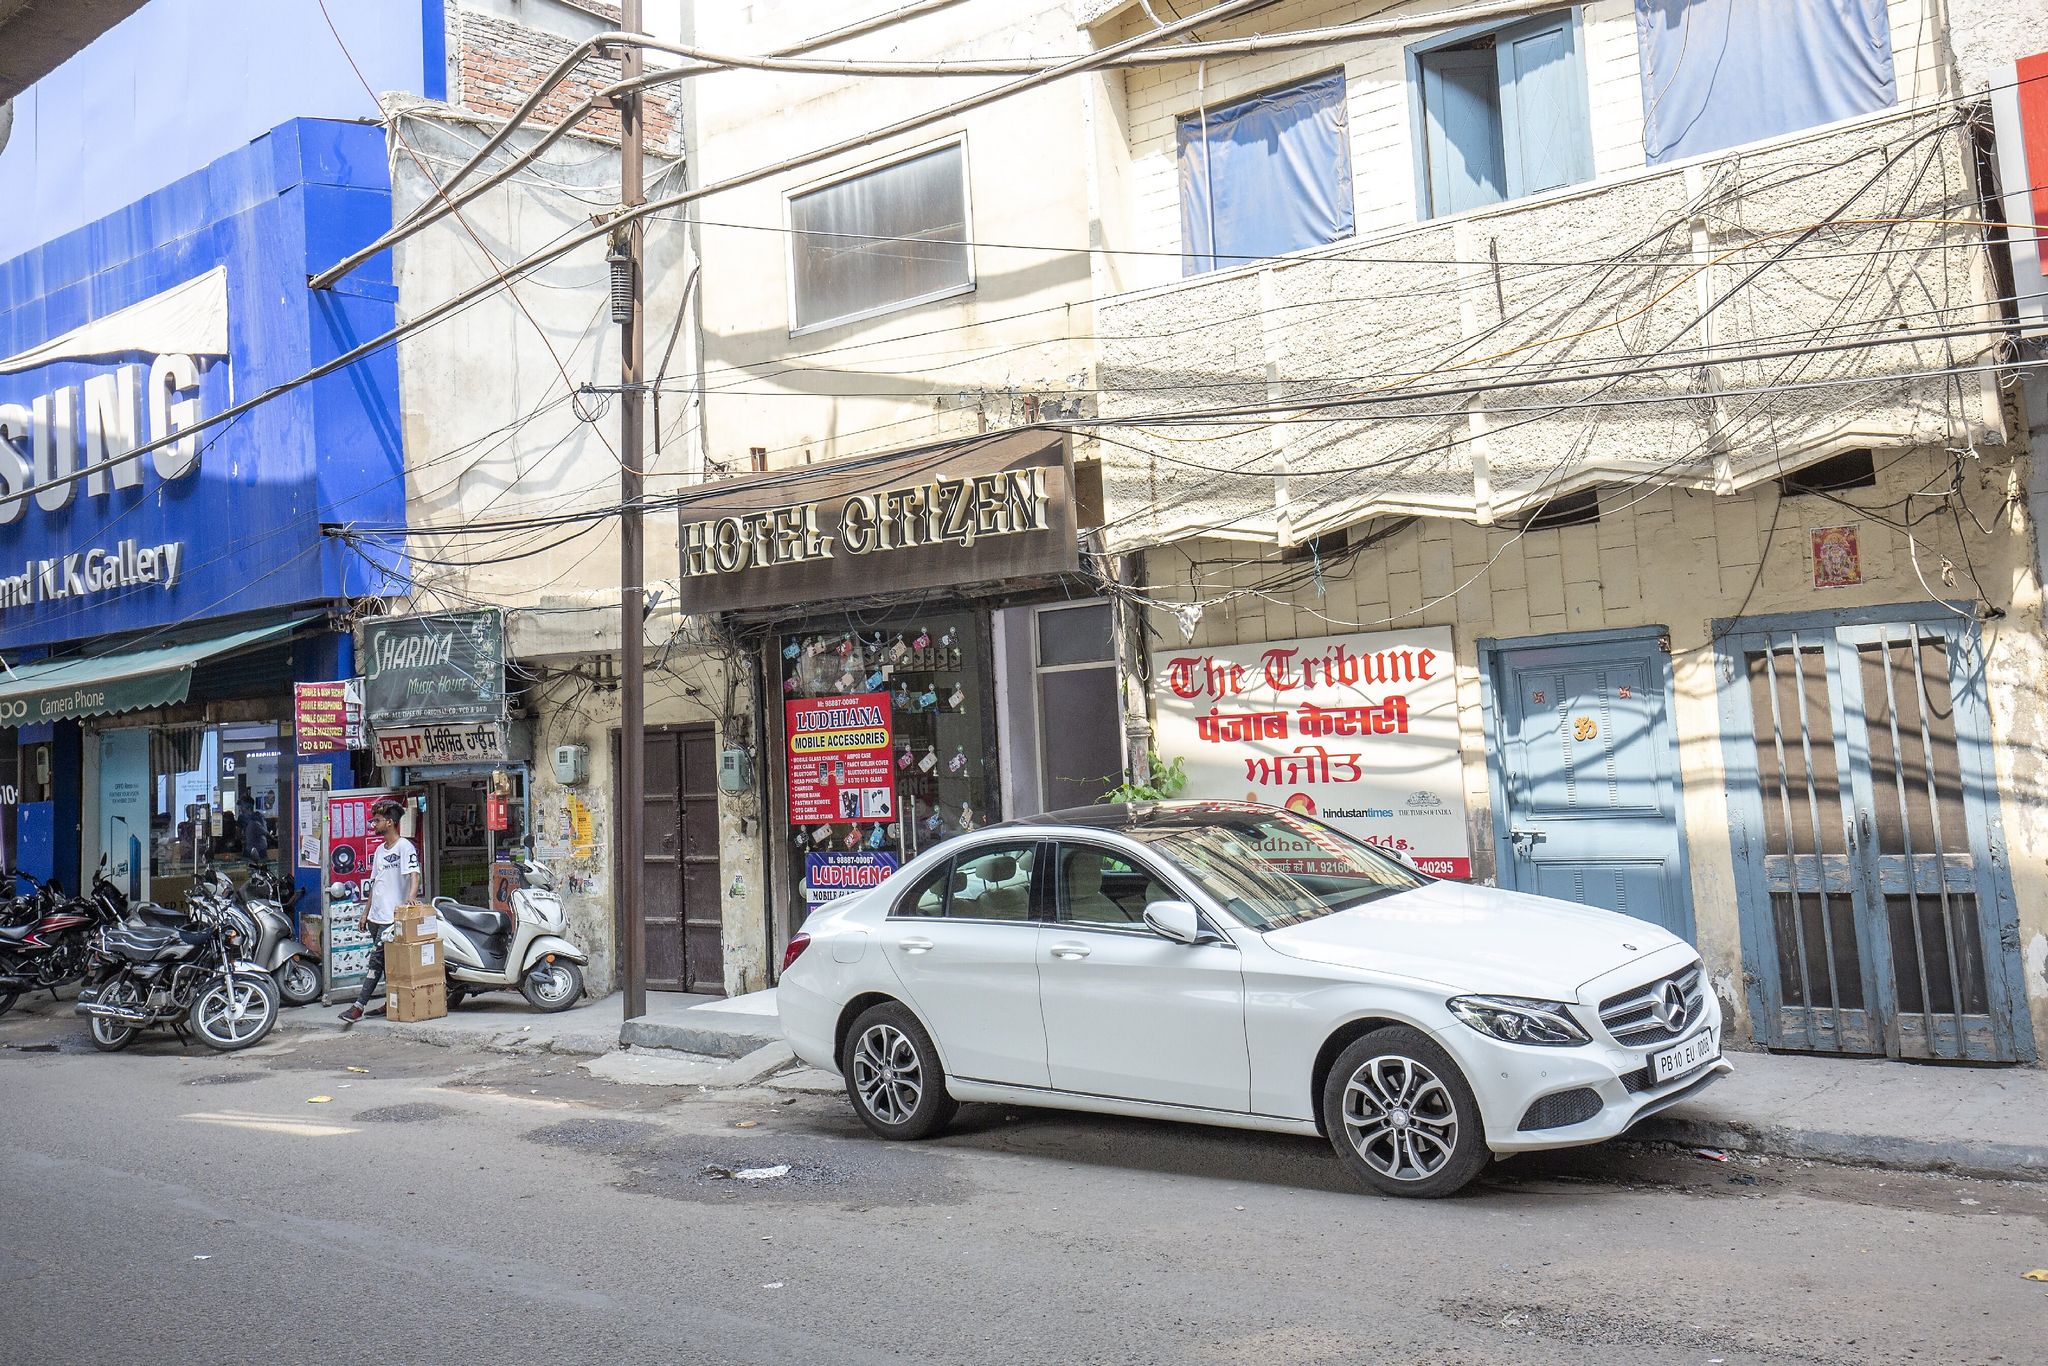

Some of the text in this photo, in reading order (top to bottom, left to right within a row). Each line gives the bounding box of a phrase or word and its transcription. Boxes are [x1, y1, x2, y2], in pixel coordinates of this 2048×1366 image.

[682, 466, 1050, 578] HOTEL CITIZEN
[368, 630, 453, 681] SHARMA
[1167, 643, 1438, 703] The Tribune
[41, 694, 74, 716] Camera
[75, 690, 105, 710] Phone
[796, 706, 884, 731] LUDHIANA
[1195, 694, 1411, 743] पंजाब केसरी
[303, 741, 333, 750] CD & DVD
[795, 731, 885, 749] MOBILE ACCESSORIES
[1245, 745, 1363, 786] ਅਜੀਤ
[1322, 806, 1394, 819] hindustantimes
[812, 865, 892, 887] LUDHIANA
[1307, 861, 1318, 873] M.
[813, 890, 837, 901] MOBILE
